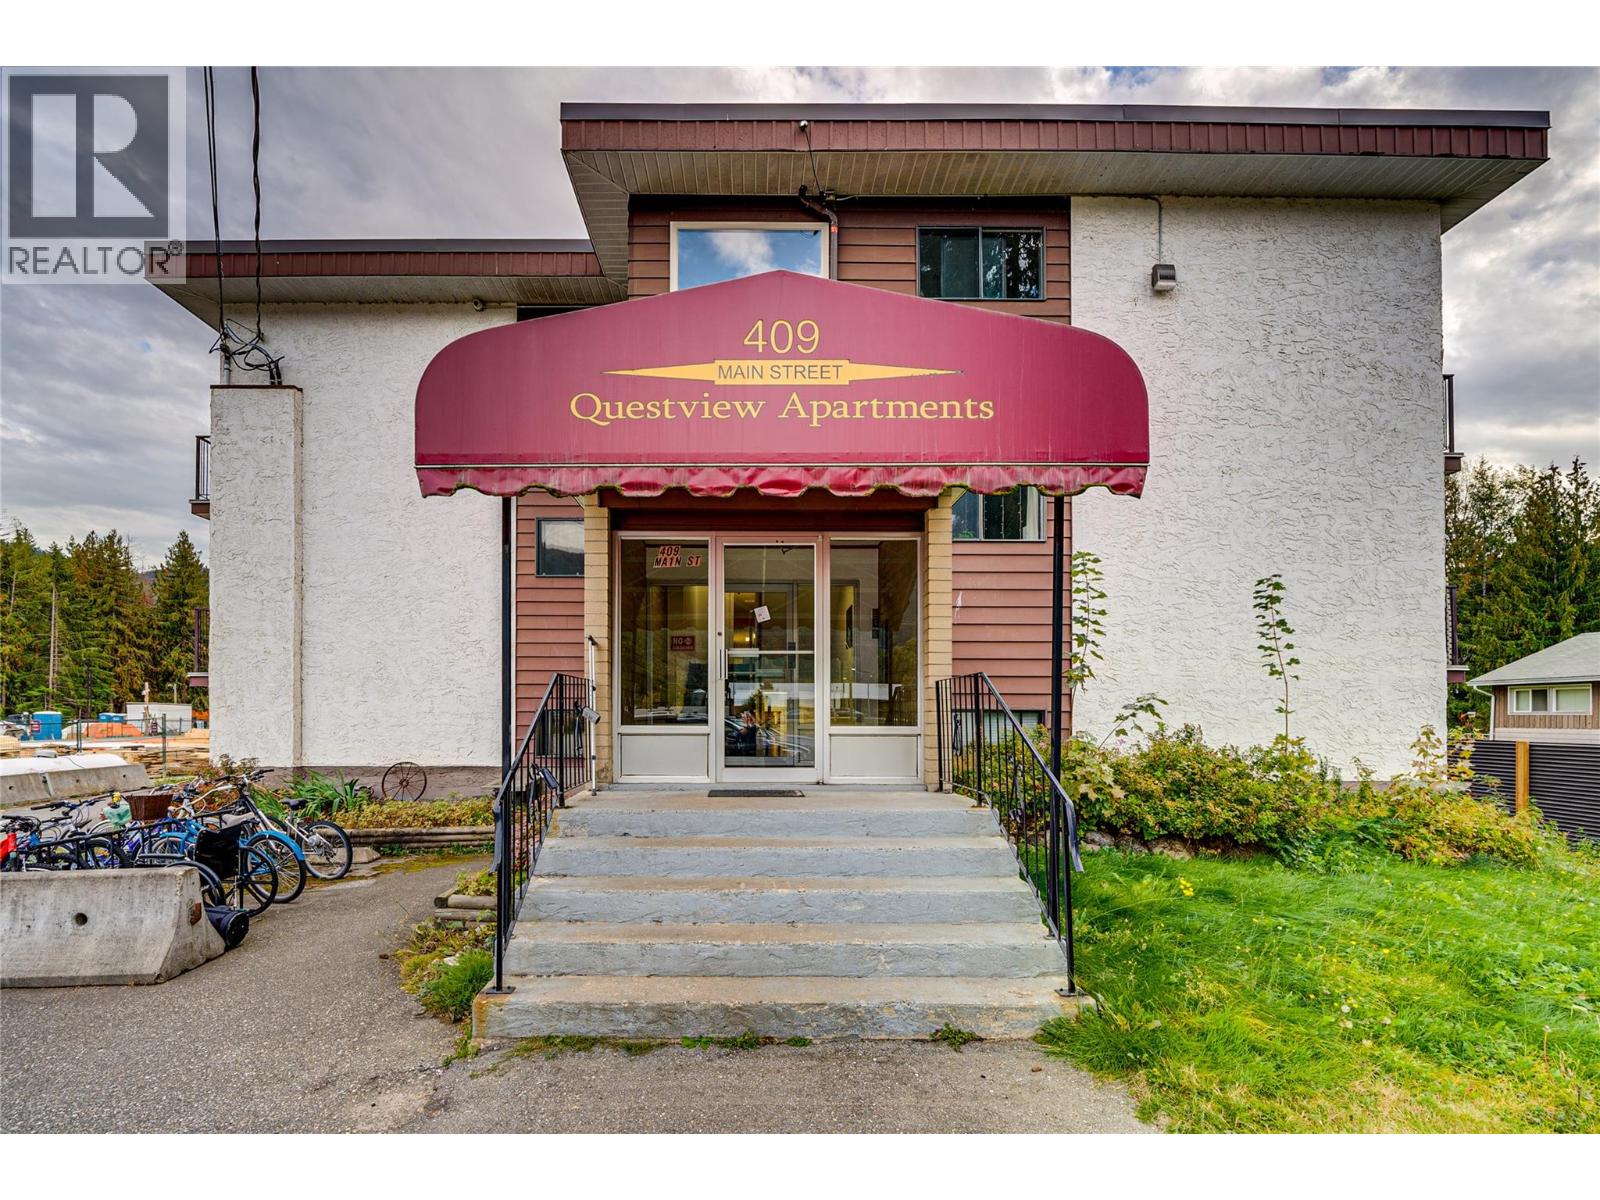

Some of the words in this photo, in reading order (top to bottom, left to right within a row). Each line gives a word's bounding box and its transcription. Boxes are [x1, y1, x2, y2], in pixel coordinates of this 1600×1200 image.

[742, 319, 821, 354] 409
[717, 364, 764, 380] MAIN
[769, 364, 843, 380] STREET
[569, 392, 766, 427] Questview
[777, 391, 995, 428] Apartments
[659, 546, 680, 557] 409
[654, 556, 682, 567] MAIN
[686, 555, 701, 566] ST
